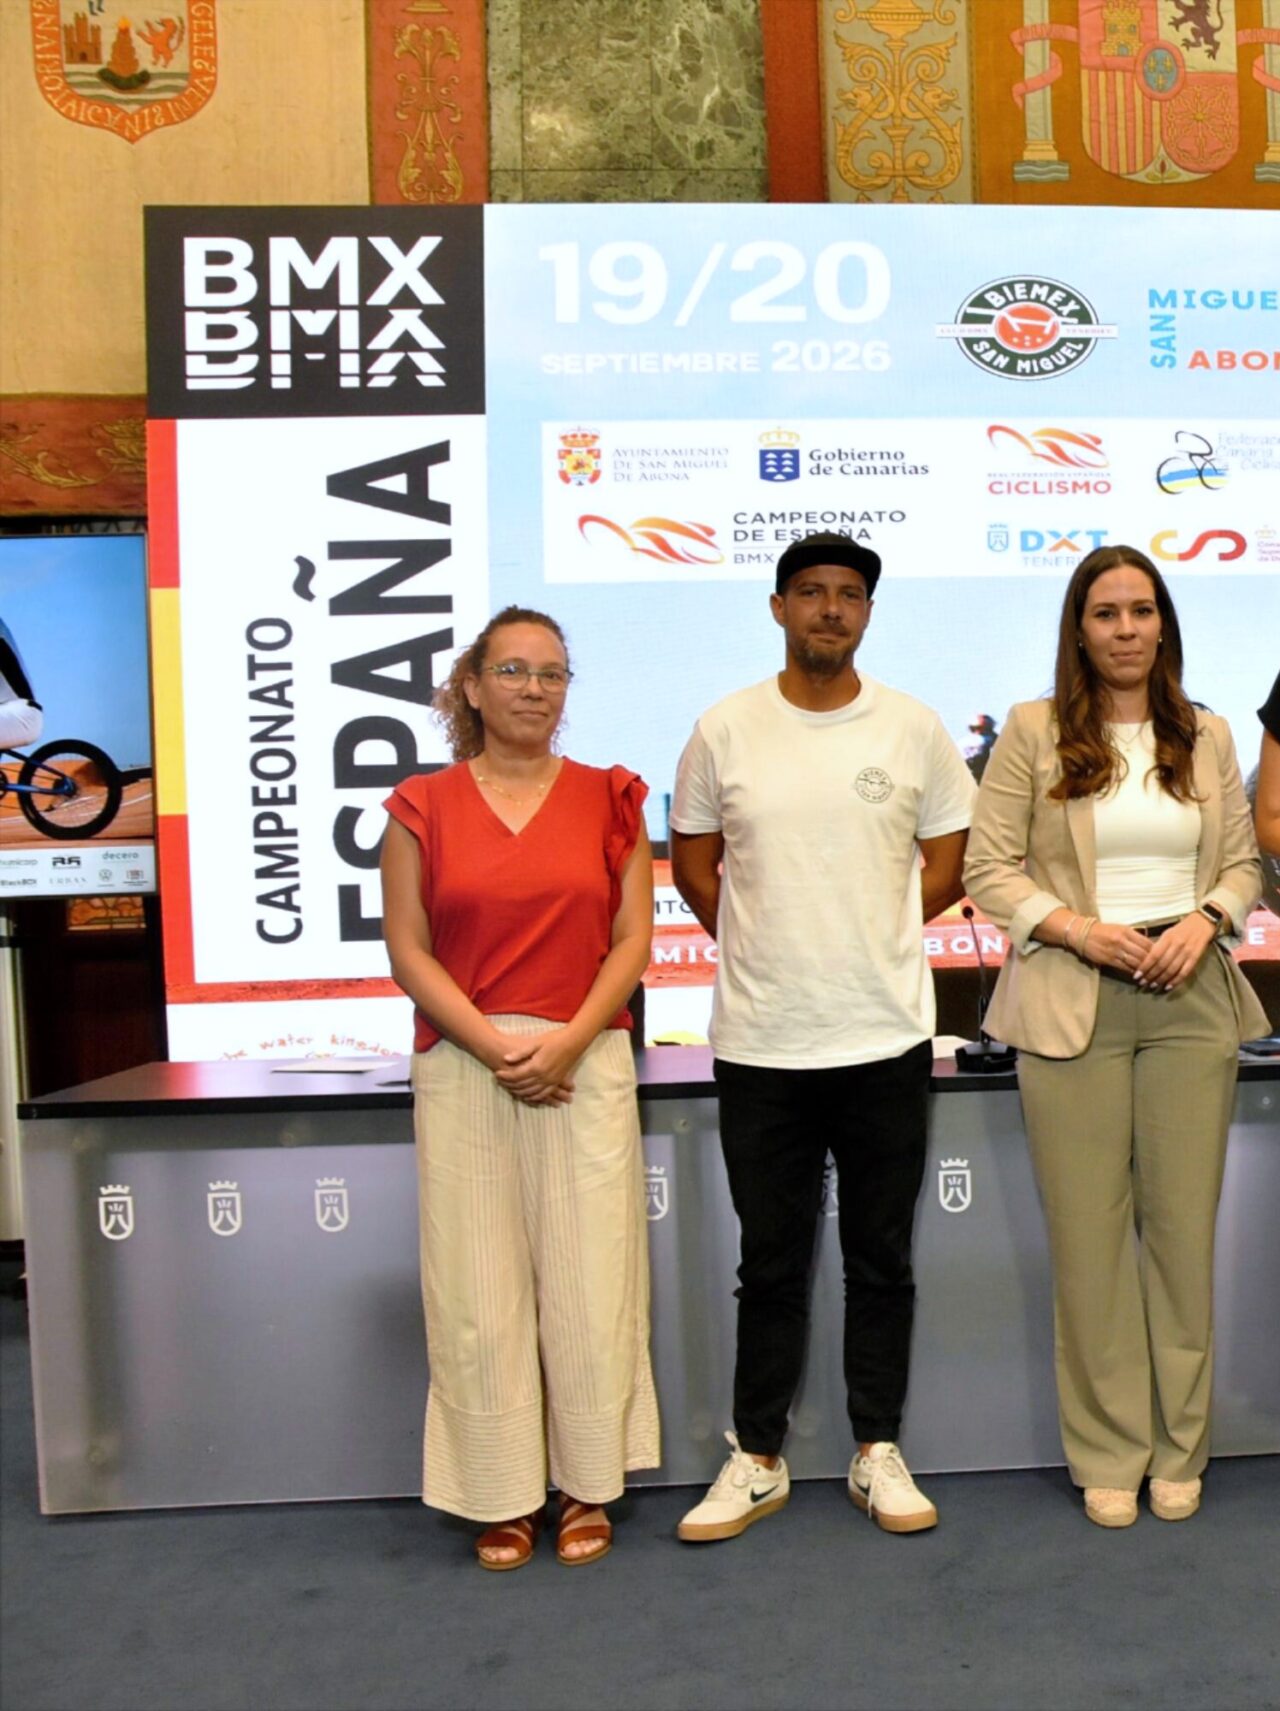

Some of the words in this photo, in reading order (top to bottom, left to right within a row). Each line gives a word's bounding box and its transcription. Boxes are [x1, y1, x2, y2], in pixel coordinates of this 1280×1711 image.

[183, 236, 446, 307] BMX
[539, 240, 892, 327] 19/20
[984, 283, 1080, 316] BIEMEX
[1150, 314, 1177, 369] SAN
[541, 352, 761, 375] SEPTIEMBRE
[771, 340, 892, 372] 2026
[973, 341, 1011, 369] SAN
[1017, 342, 1084, 373] MIGUEL
[613, 447, 729, 457] AYUNTAMIENTO
[809, 448, 905, 462] Gobierno
[639, 460, 667, 469] SAN
[809, 462, 833, 476] de
[839, 461, 929, 476] Canarias
[639, 472, 690, 481] ABONA
[988, 480, 1111, 495] CICLISMO
[733, 510, 907, 525] CAMPEONATO
[733, 529, 765, 542] DE
[775, 525, 872, 541] ESPÑA
[1020, 530, 1109, 552] DXT
[733, 553, 775, 565] BMX
[1023, 556, 1081, 567] TENERI
[246, 616, 304, 944] CAMPEONATO
[924, 935, 1004, 956] BON
[1247, 927, 1266, 946] E
